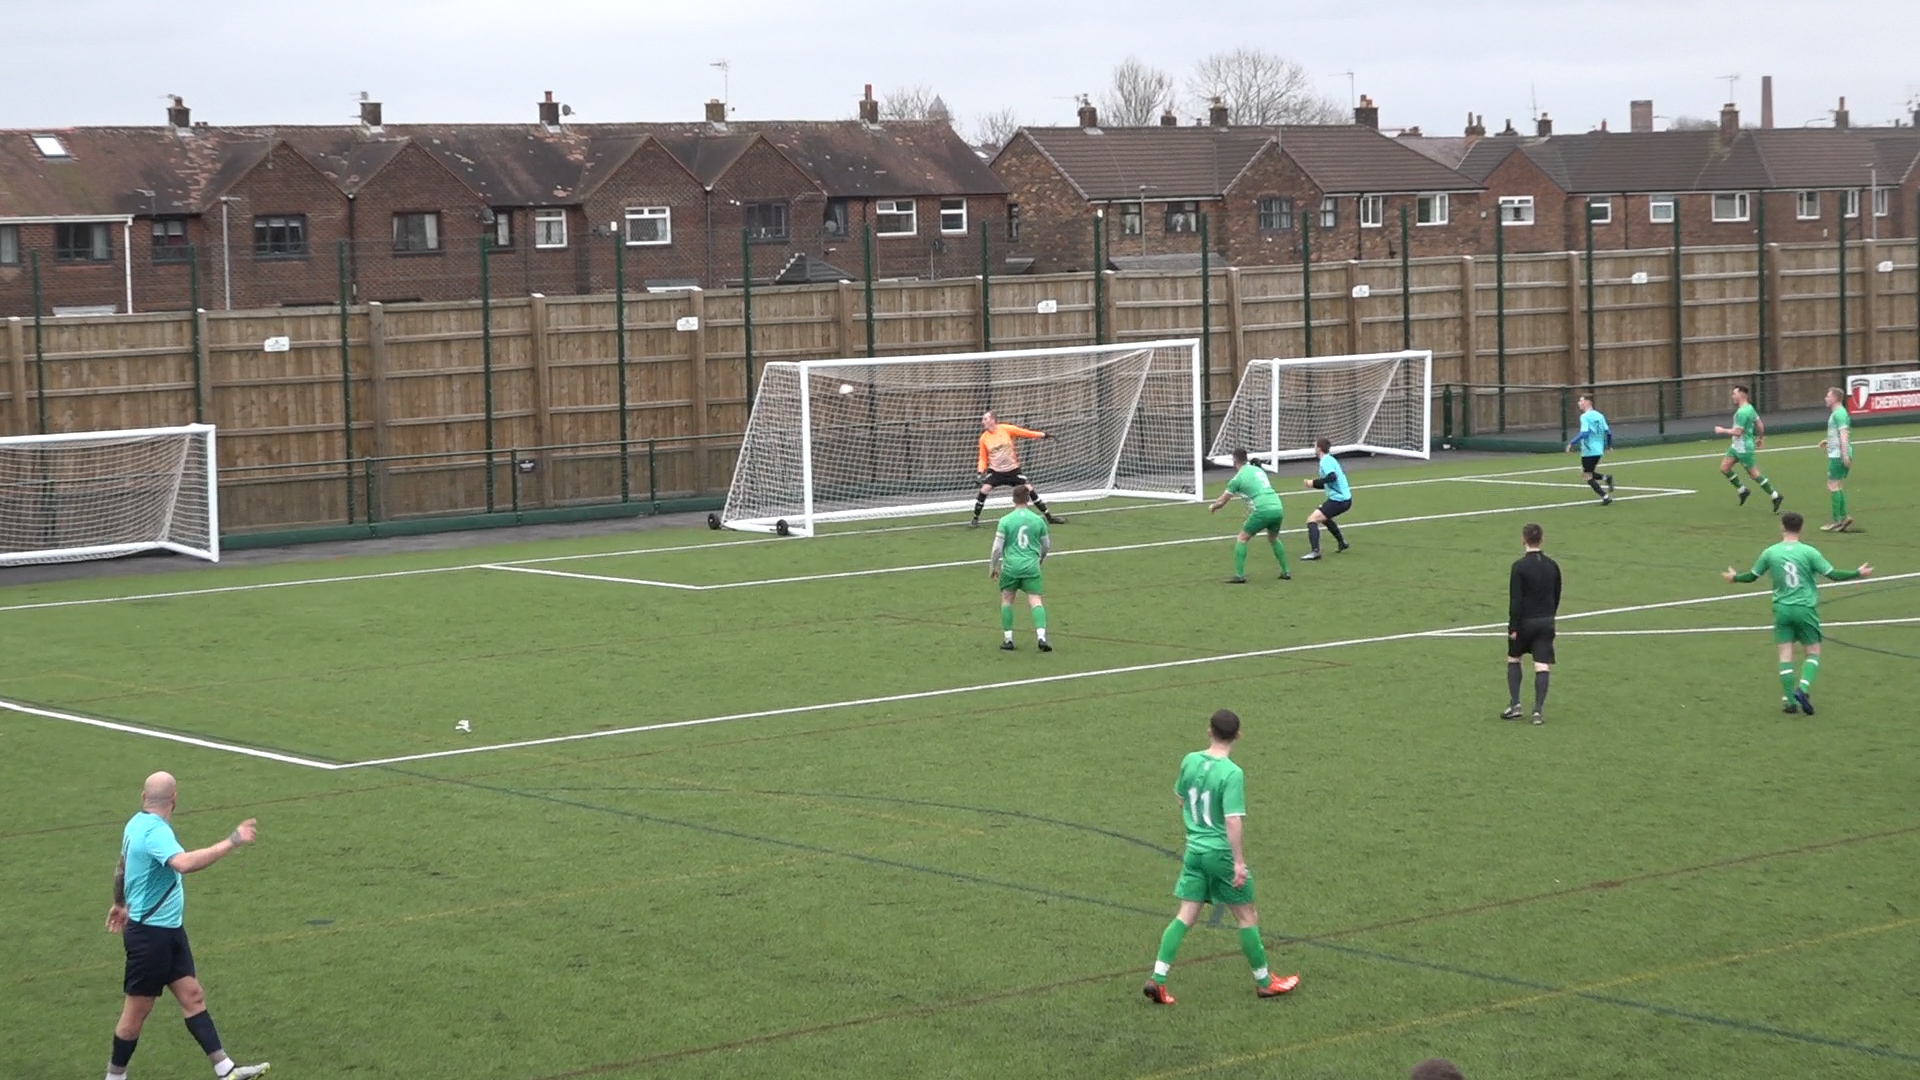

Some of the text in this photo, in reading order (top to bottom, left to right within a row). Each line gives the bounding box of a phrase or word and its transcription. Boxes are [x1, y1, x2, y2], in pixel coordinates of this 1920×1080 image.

[1017, 525, 1029, 550] 6
[1783, 561, 1799, 588] 8
[1188, 787, 1213, 827] 11
